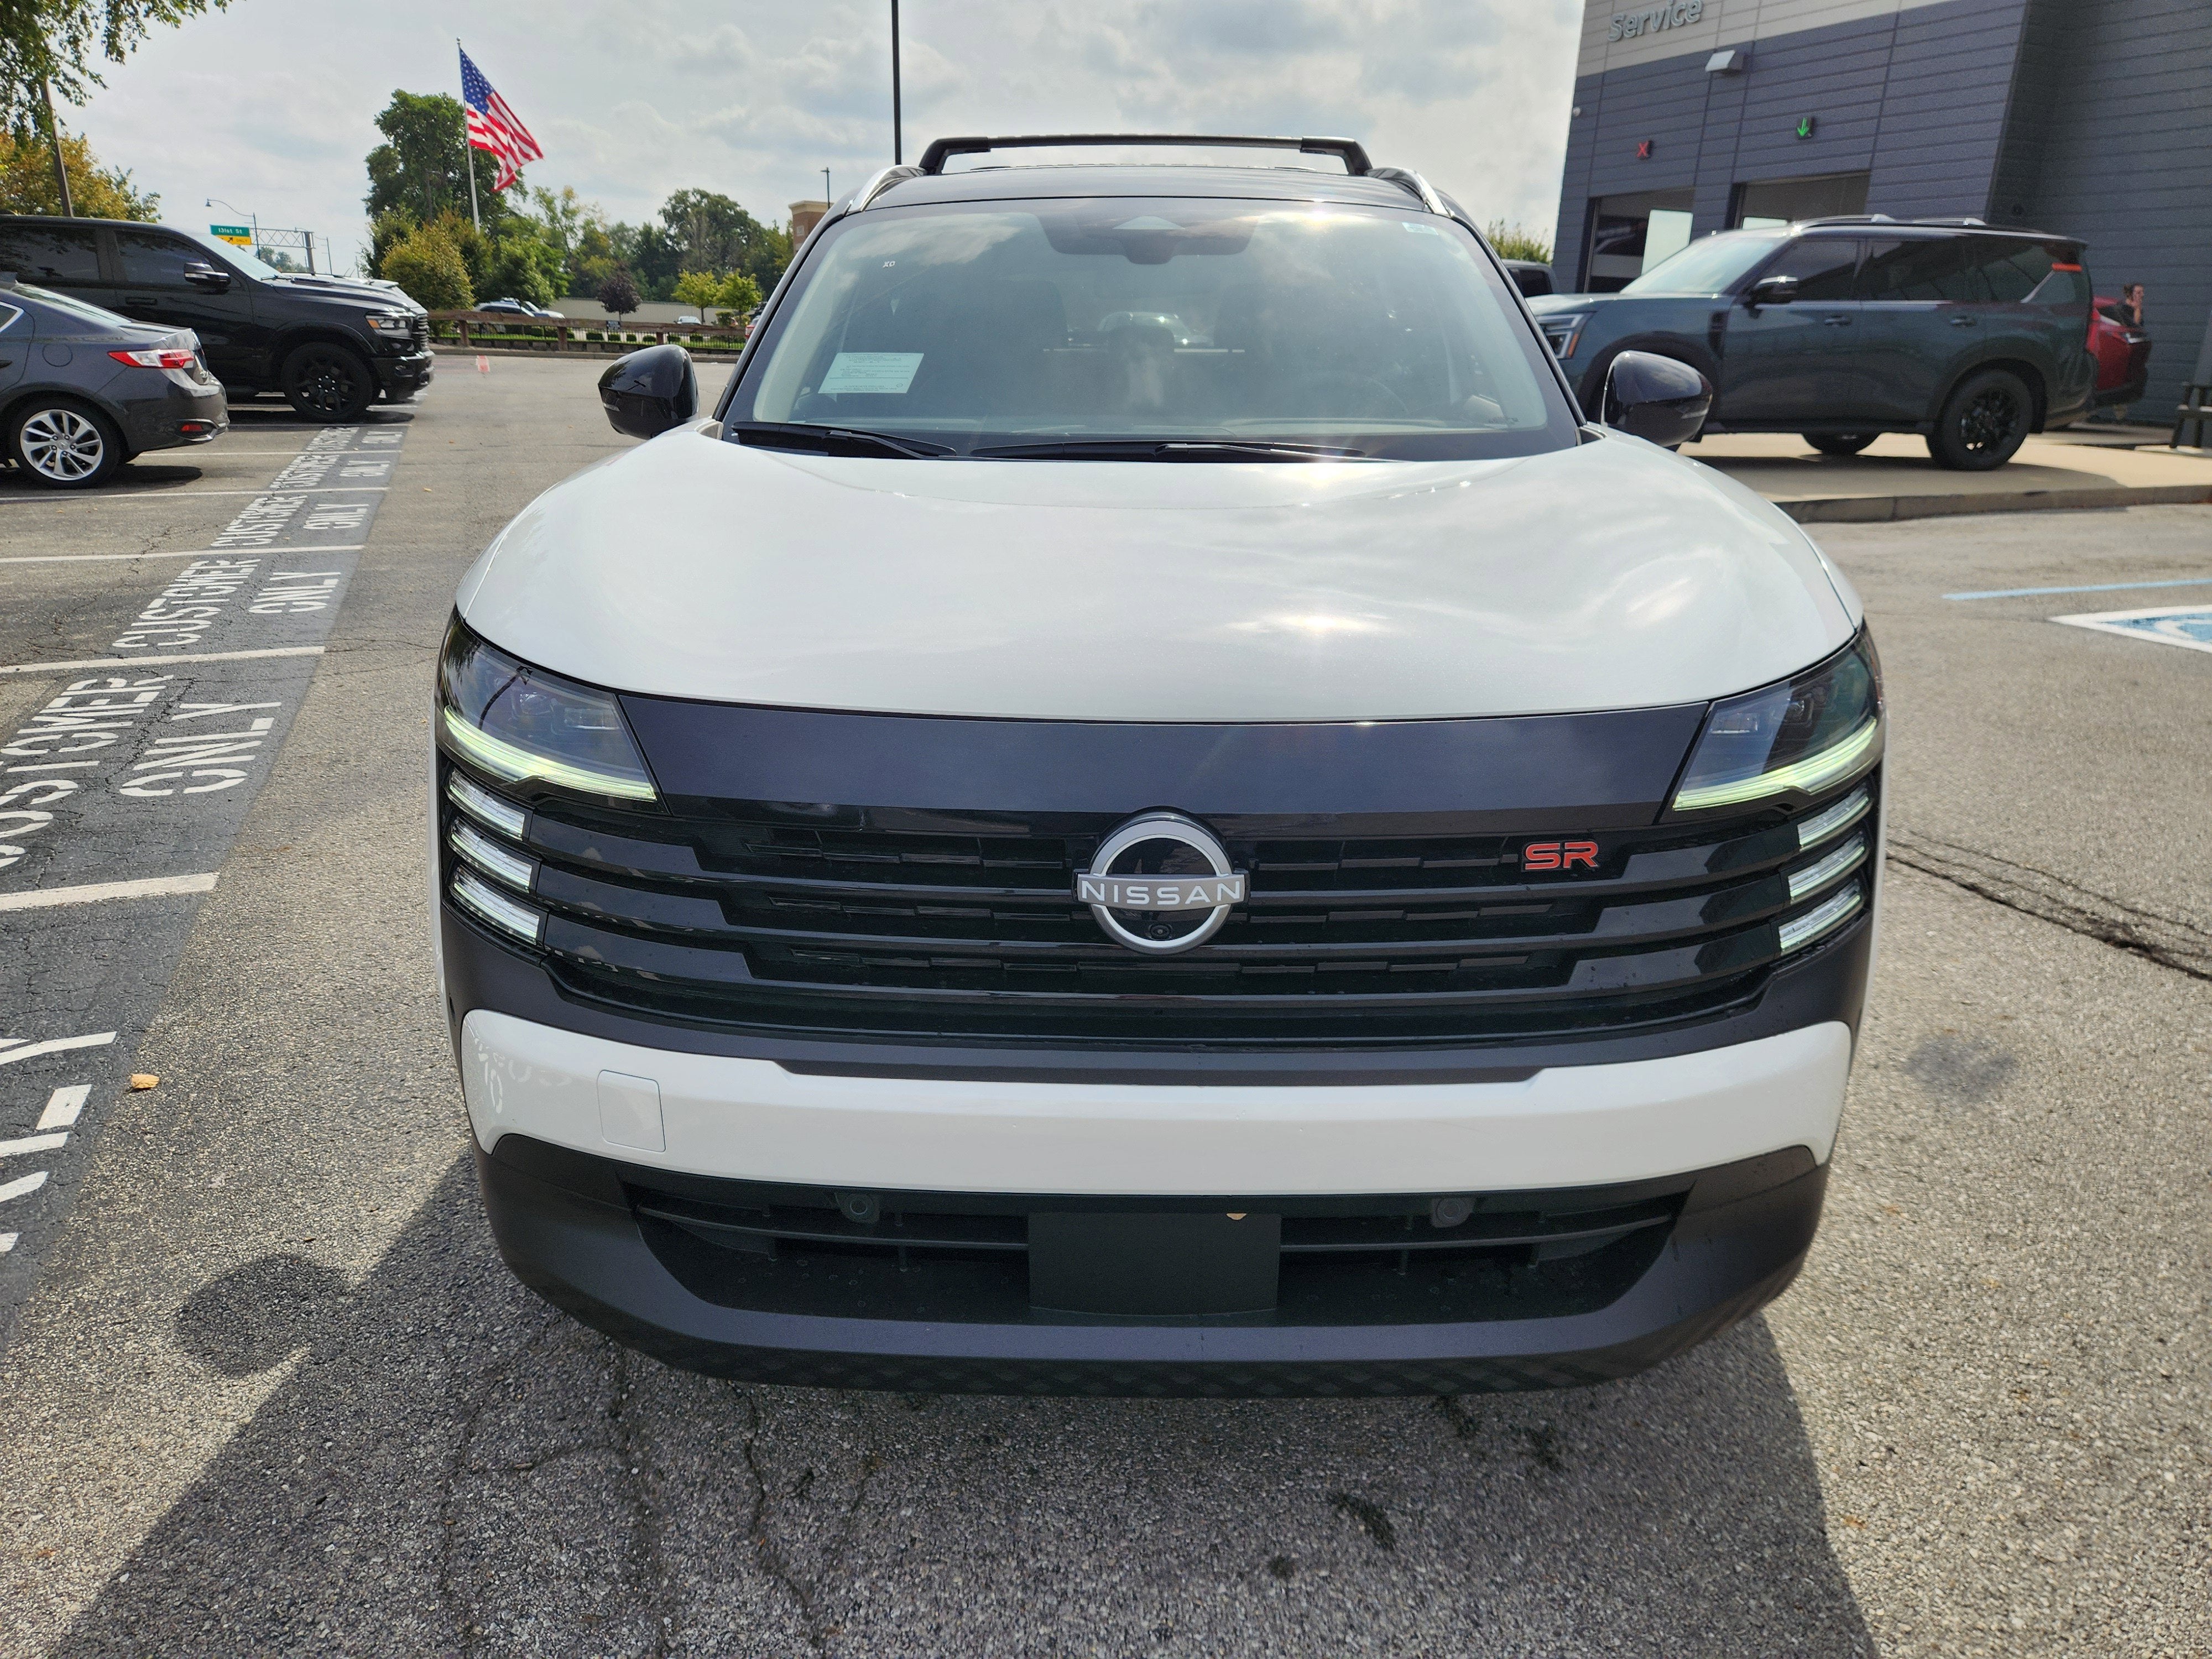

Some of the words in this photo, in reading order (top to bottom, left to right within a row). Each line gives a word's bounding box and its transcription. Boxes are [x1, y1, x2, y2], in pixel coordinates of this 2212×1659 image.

[1608, 0, 1702, 41] Service
[210, 495, 307, 546] CUSTOMER
[303, 504, 369, 530] ONLY
[112, 559, 262, 648] CUSTOMER
[248, 572, 341, 614] ONLY
[119, 702, 281, 797] ONLY
[1525, 841, 1598, 870] SR
[1082, 880, 1240, 905] NISSAN
